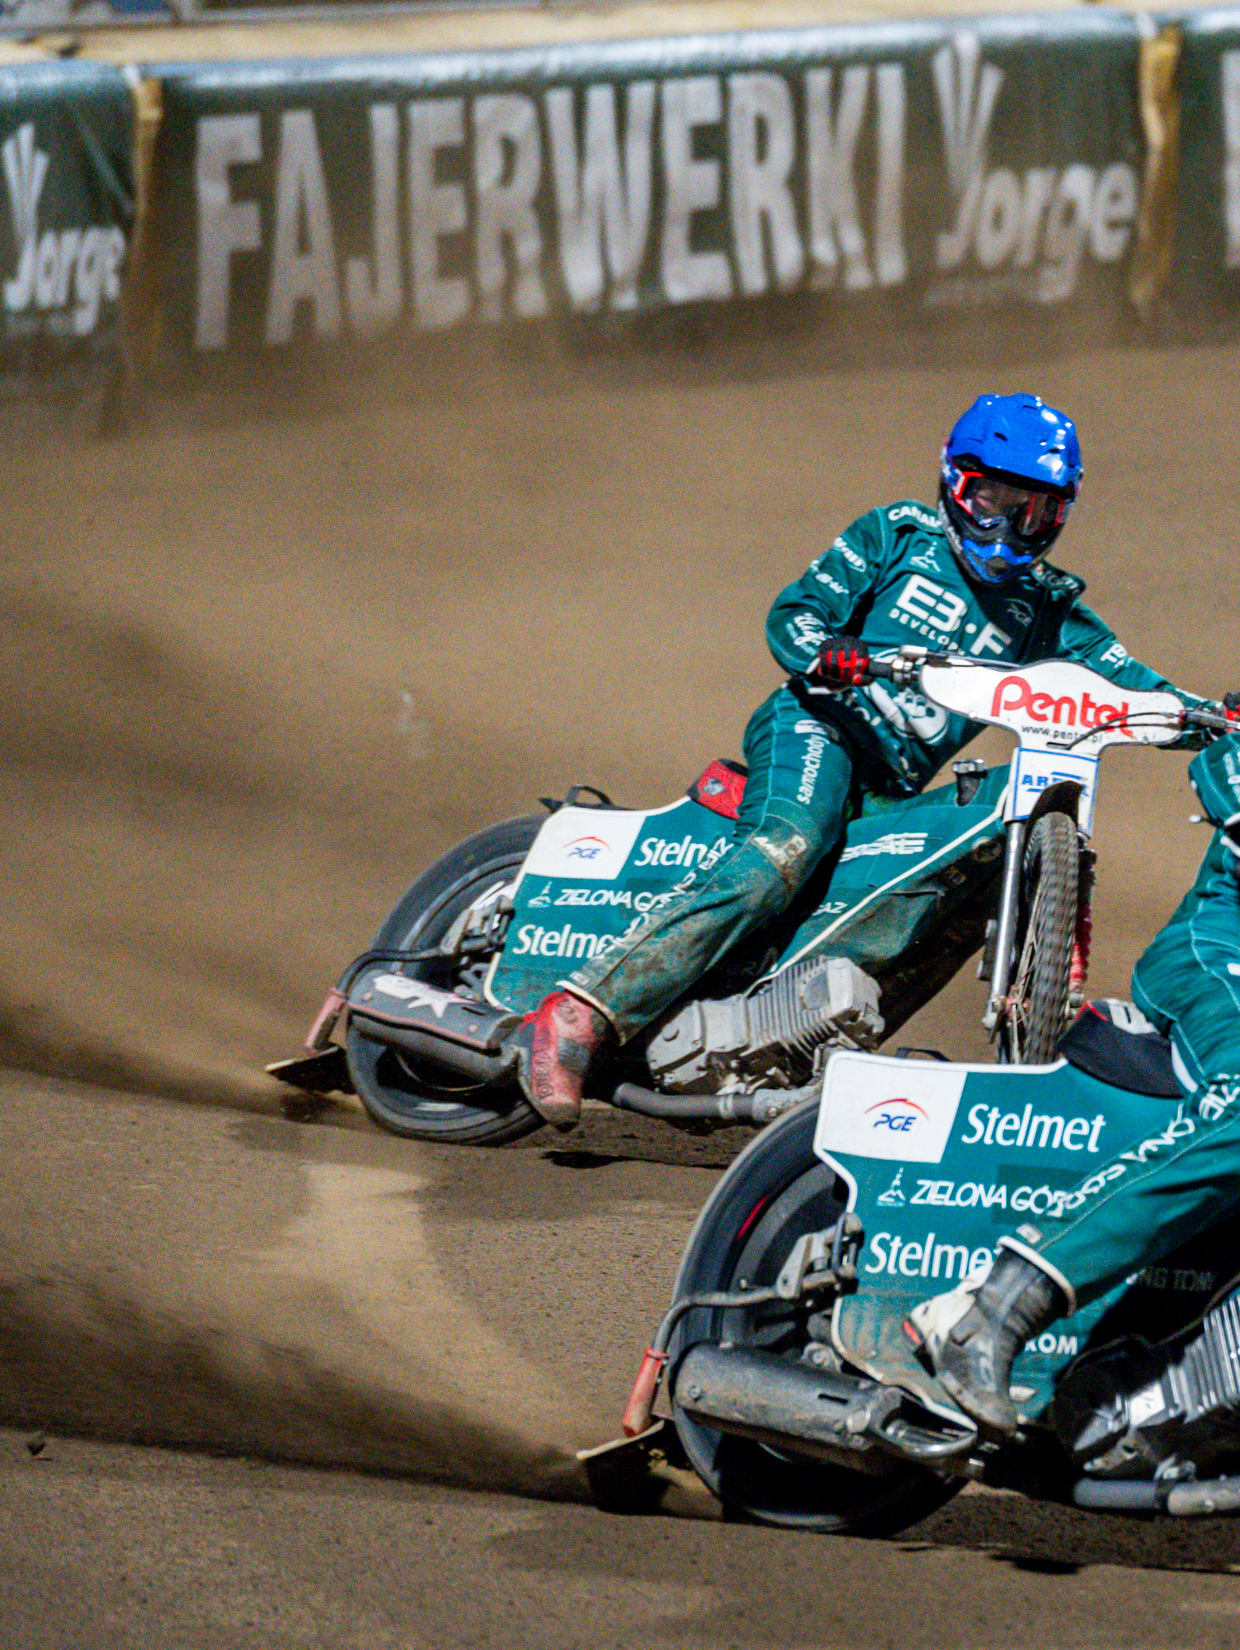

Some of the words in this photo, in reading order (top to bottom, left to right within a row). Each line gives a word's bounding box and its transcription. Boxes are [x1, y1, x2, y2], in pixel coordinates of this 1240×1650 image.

[195, 60, 906, 350] FAJERWERKI
[990, 676, 1135, 738] Pentel
[873, 1113, 916, 1132] PGE
[961, 1102, 1106, 1153] Stelmet
